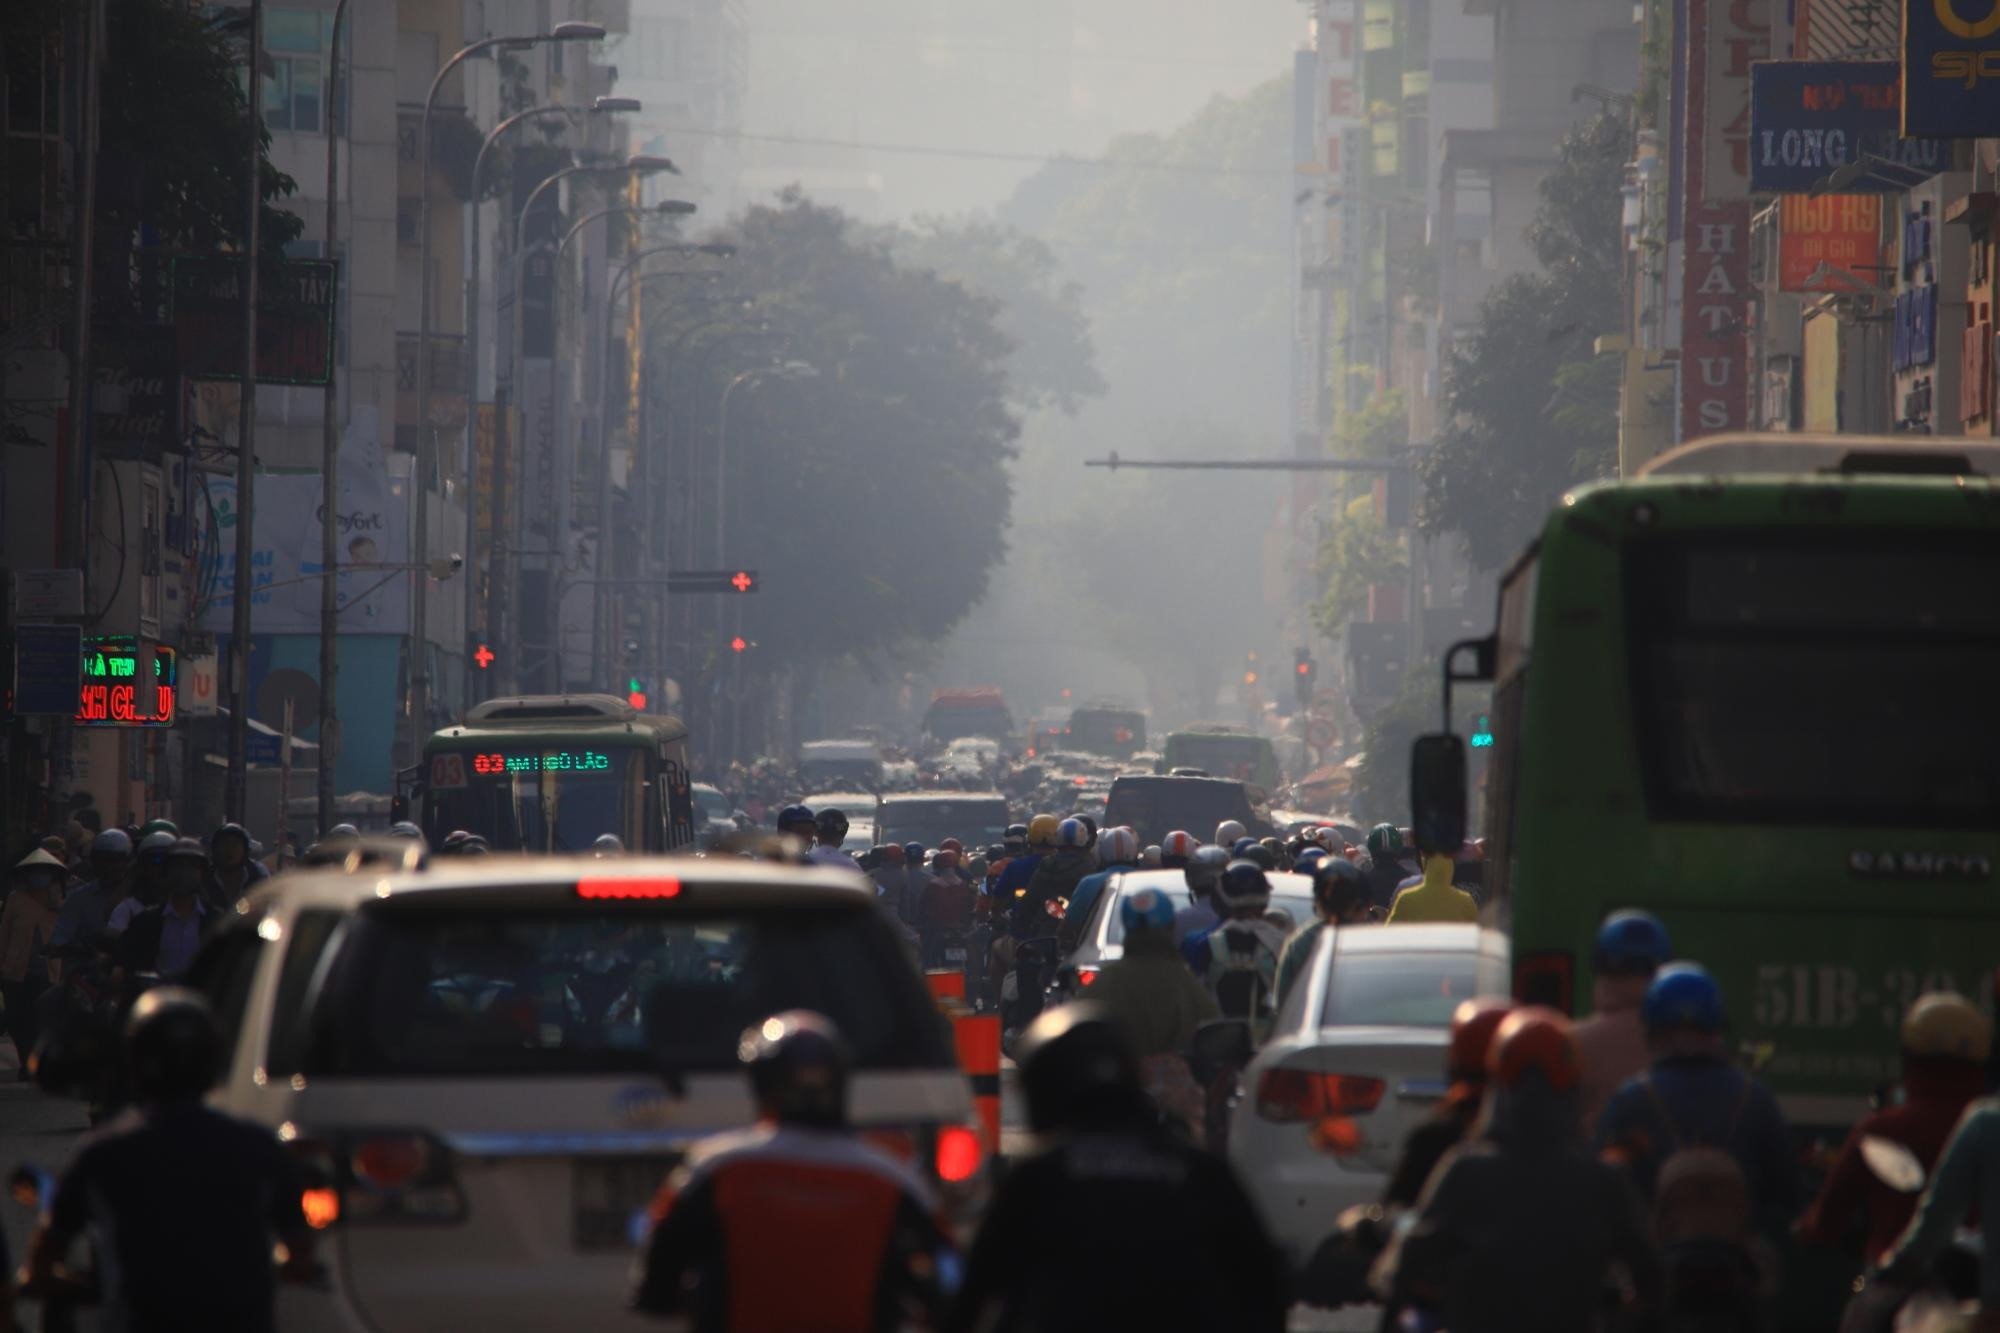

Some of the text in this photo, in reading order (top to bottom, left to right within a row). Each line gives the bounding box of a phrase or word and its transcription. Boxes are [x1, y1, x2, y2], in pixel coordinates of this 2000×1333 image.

[1761, 128, 1846, 168] LONG
[111, 684, 173, 721] CHU
[432, 755, 463, 786] 03
[475, 753, 505, 775] 03
